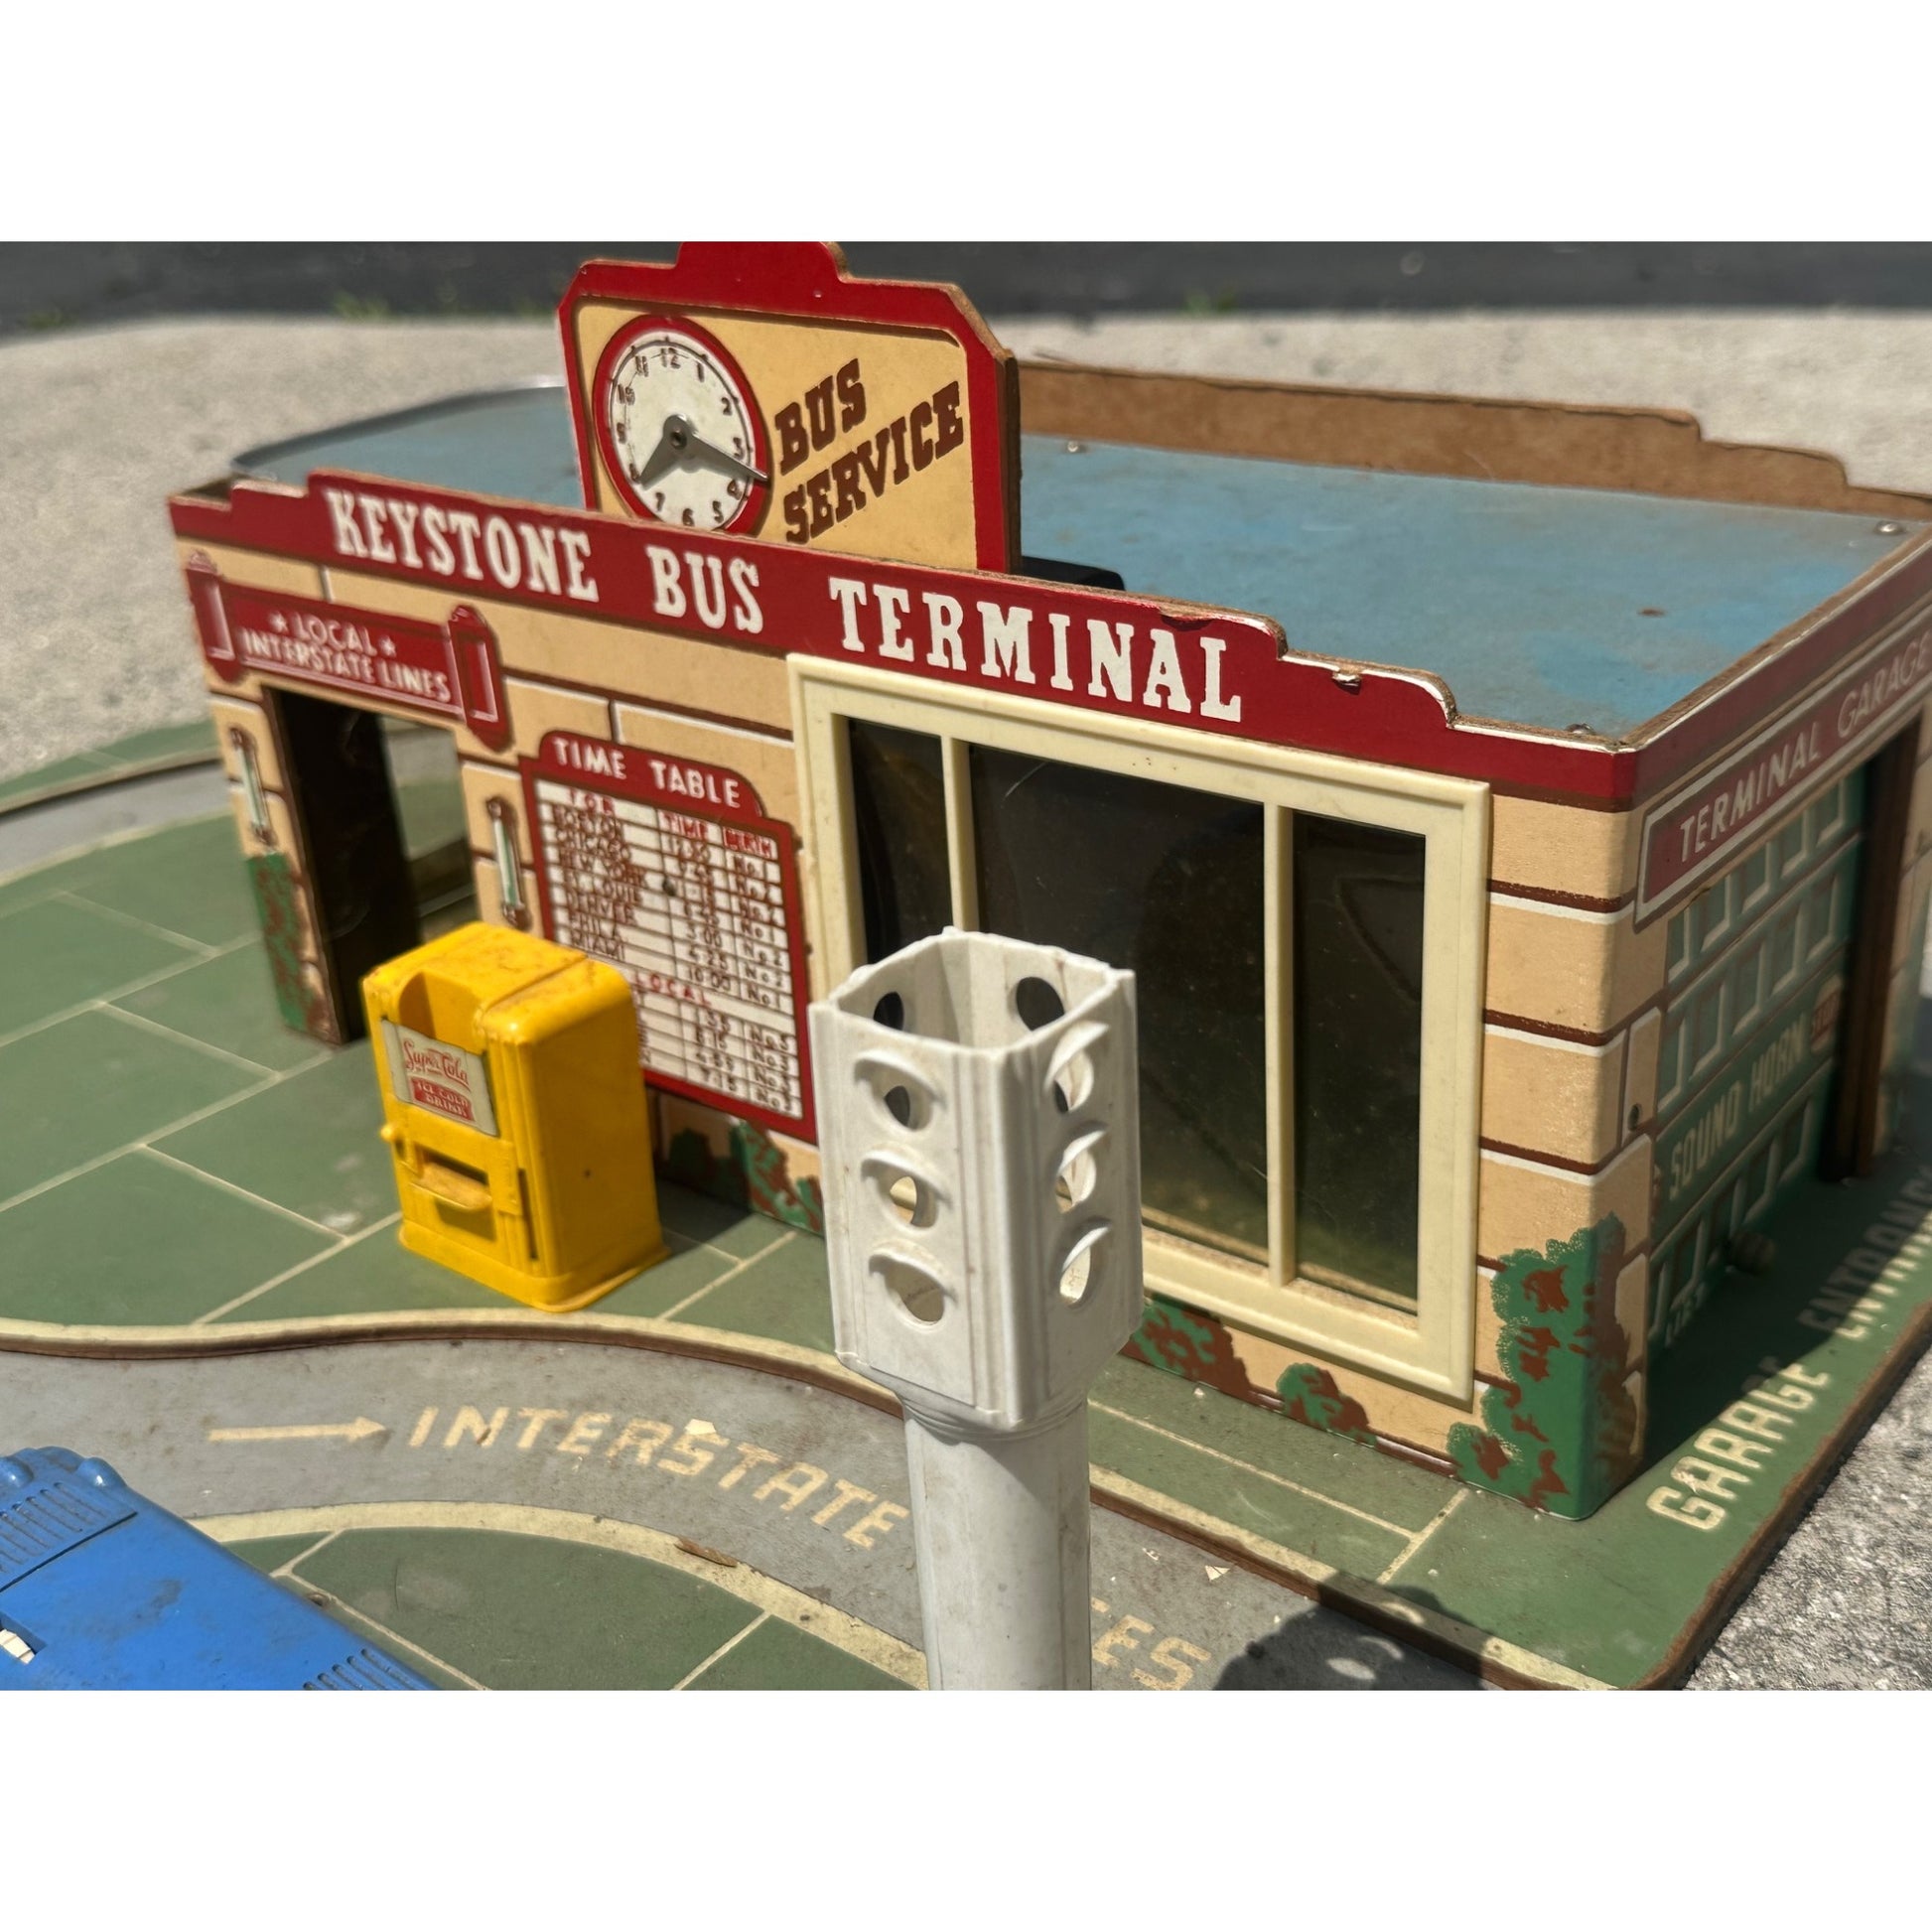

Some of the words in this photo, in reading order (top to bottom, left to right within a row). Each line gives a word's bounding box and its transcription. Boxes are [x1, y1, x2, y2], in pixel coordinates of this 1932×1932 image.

[660, 347, 681, 369] 12
[696, 361, 706, 383] 1
[618, 383, 635, 406] 10
[721, 397, 733, 416] 2
[617, 423, 627, 444] 9
[774, 357, 867, 476] BUS
[733, 437, 745, 458] 3
[782, 380, 964, 545] SERVICE
[654, 491, 666, 512] 7
[681, 507, 695, 527] 6
[712, 500, 725, 523] 5
[326, 487, 599, 603] KEYSTONE
[645, 544, 764, 635] BUS
[828, 576, 1242, 723] TERMINAL
[293, 612, 377, 657] LOCAL
[238, 626, 376, 684] INTERSTATE
[375, 657, 452, 703] LINES
[552, 737, 627, 780] TIME
[649, 759, 742, 809] TABLE
[1679, 721, 1821, 863] TERMINAL
[632, 971, 713, 1009] LOCAL
[431, 1048, 472, 1091] Cola
[440, 1088, 469, 1108] COLD
[1669, 1079, 1742, 1200] SOUND
[1748, 1012, 1806, 1113] HORN
[1646, 1356, 1833, 1532] GARAGE
[1795, 1164, 1932, 1340] ENTRANC
[406, 1406, 910, 1551] INTERSTATE
